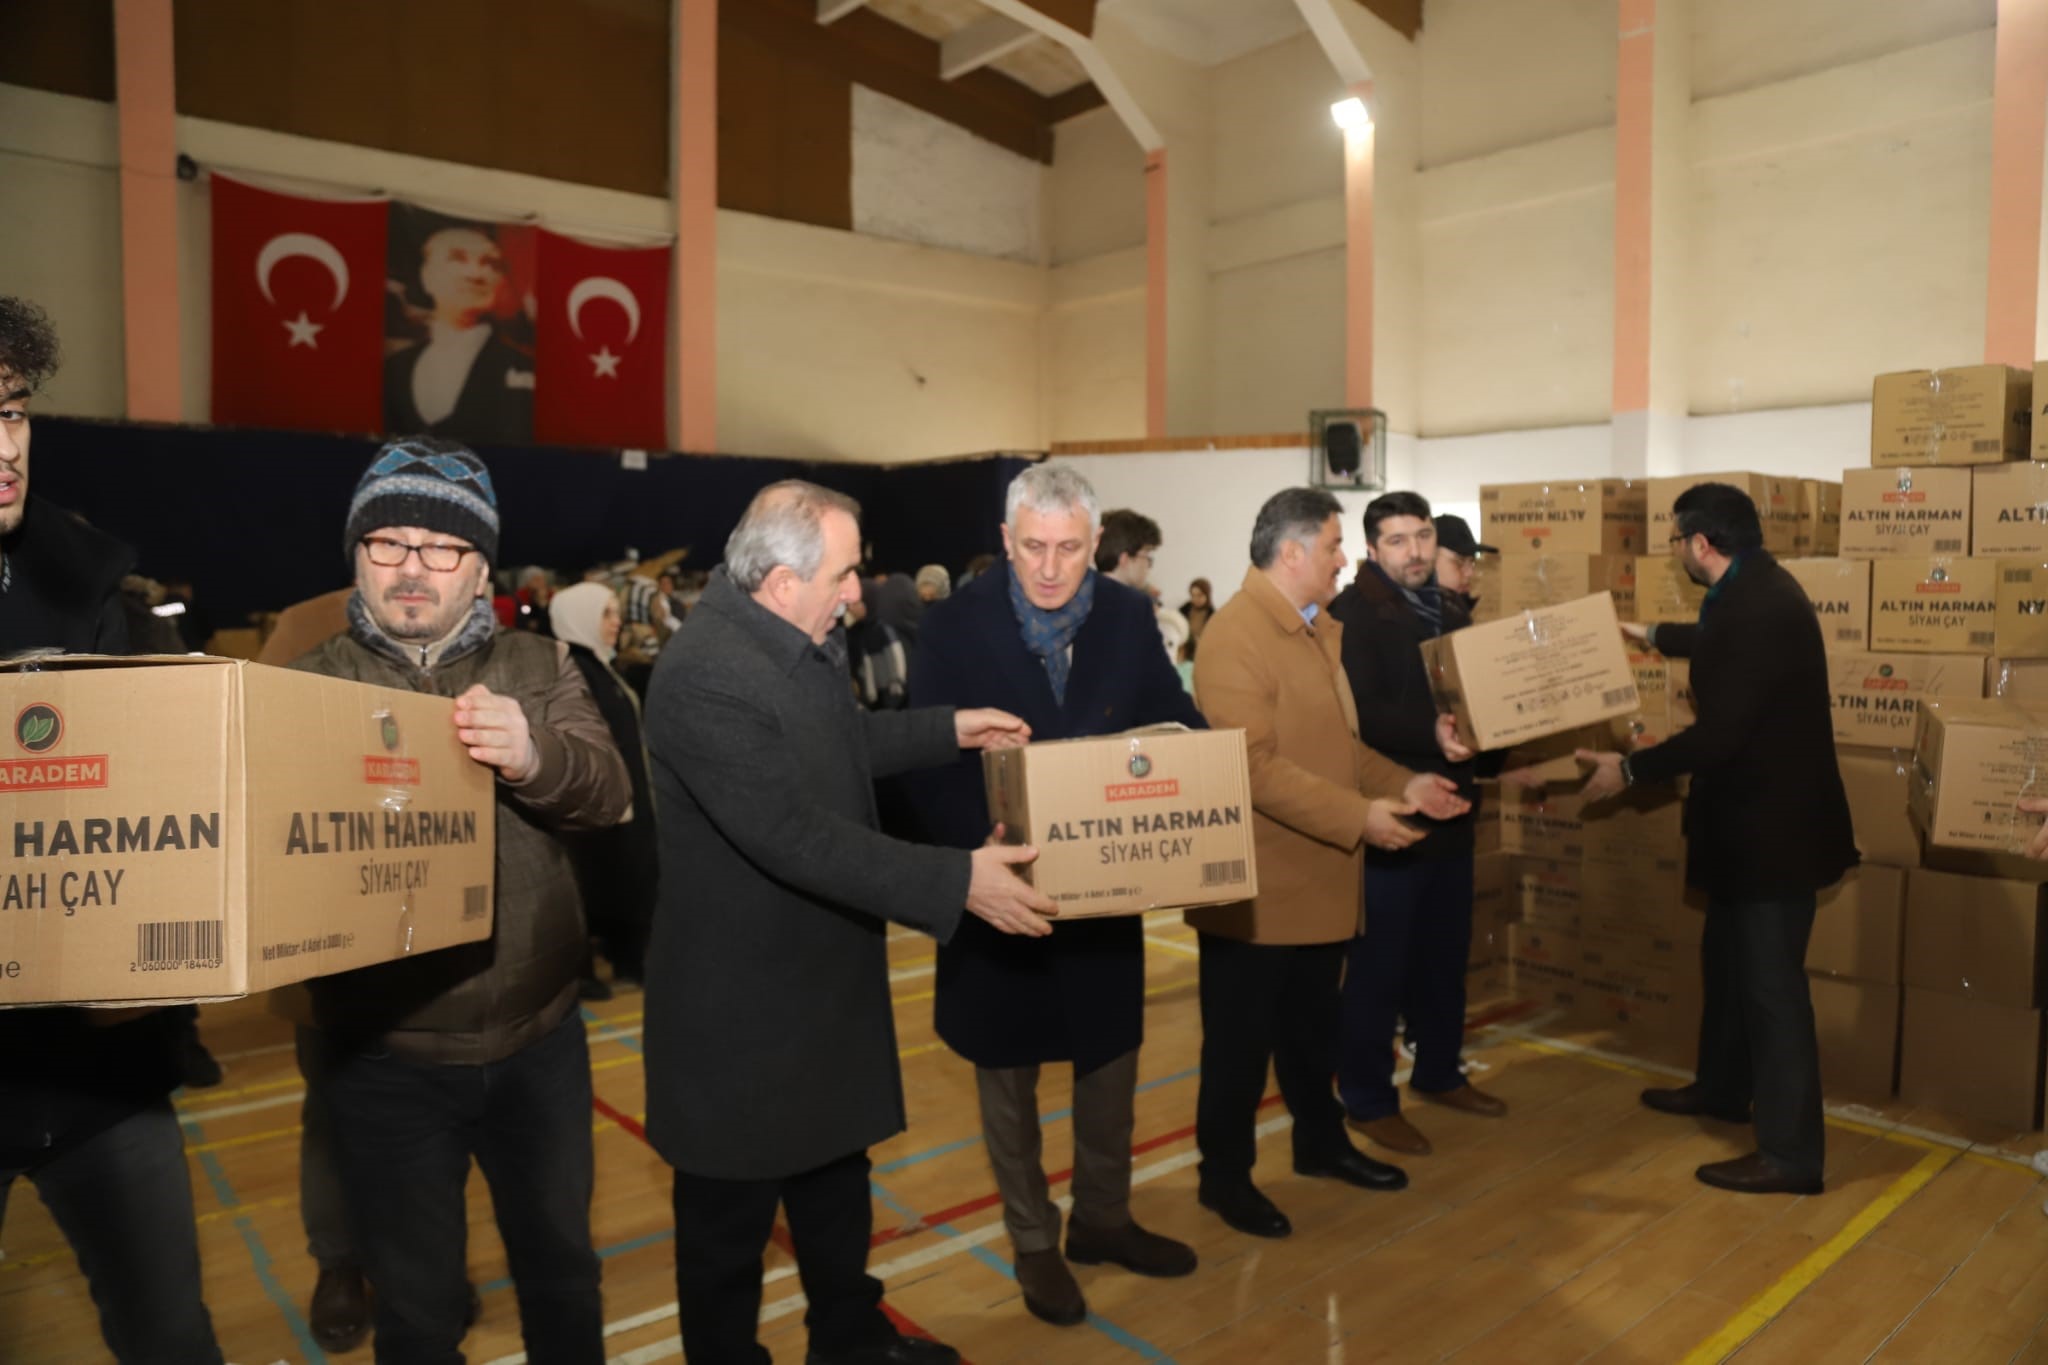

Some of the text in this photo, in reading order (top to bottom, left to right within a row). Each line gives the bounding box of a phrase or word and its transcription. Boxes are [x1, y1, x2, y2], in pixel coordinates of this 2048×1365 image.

[1848, 510, 1890, 521] ALTIN
[1896, 509, 1962, 521] HARMAN
[1998, 507, 2048, 522] ALTI
[1814, 601, 1850, 614] MAN
[1880, 601, 1995, 613] ALTIN HARMAN
[0, 763, 101, 784] ARADEM
[1108, 784, 1176, 797] KARADEM
[14, 812, 220, 858] HARMAN
[286, 810, 477, 855] ALTIN HARMAN
[1047, 806, 1241, 842] ALTIN HARMAN
[1100, 838, 1193, 864] SİYAH ÇAY
[360, 858, 430, 896] SİYAH ÇAY
[60, 869, 125, 916] ÇAY
